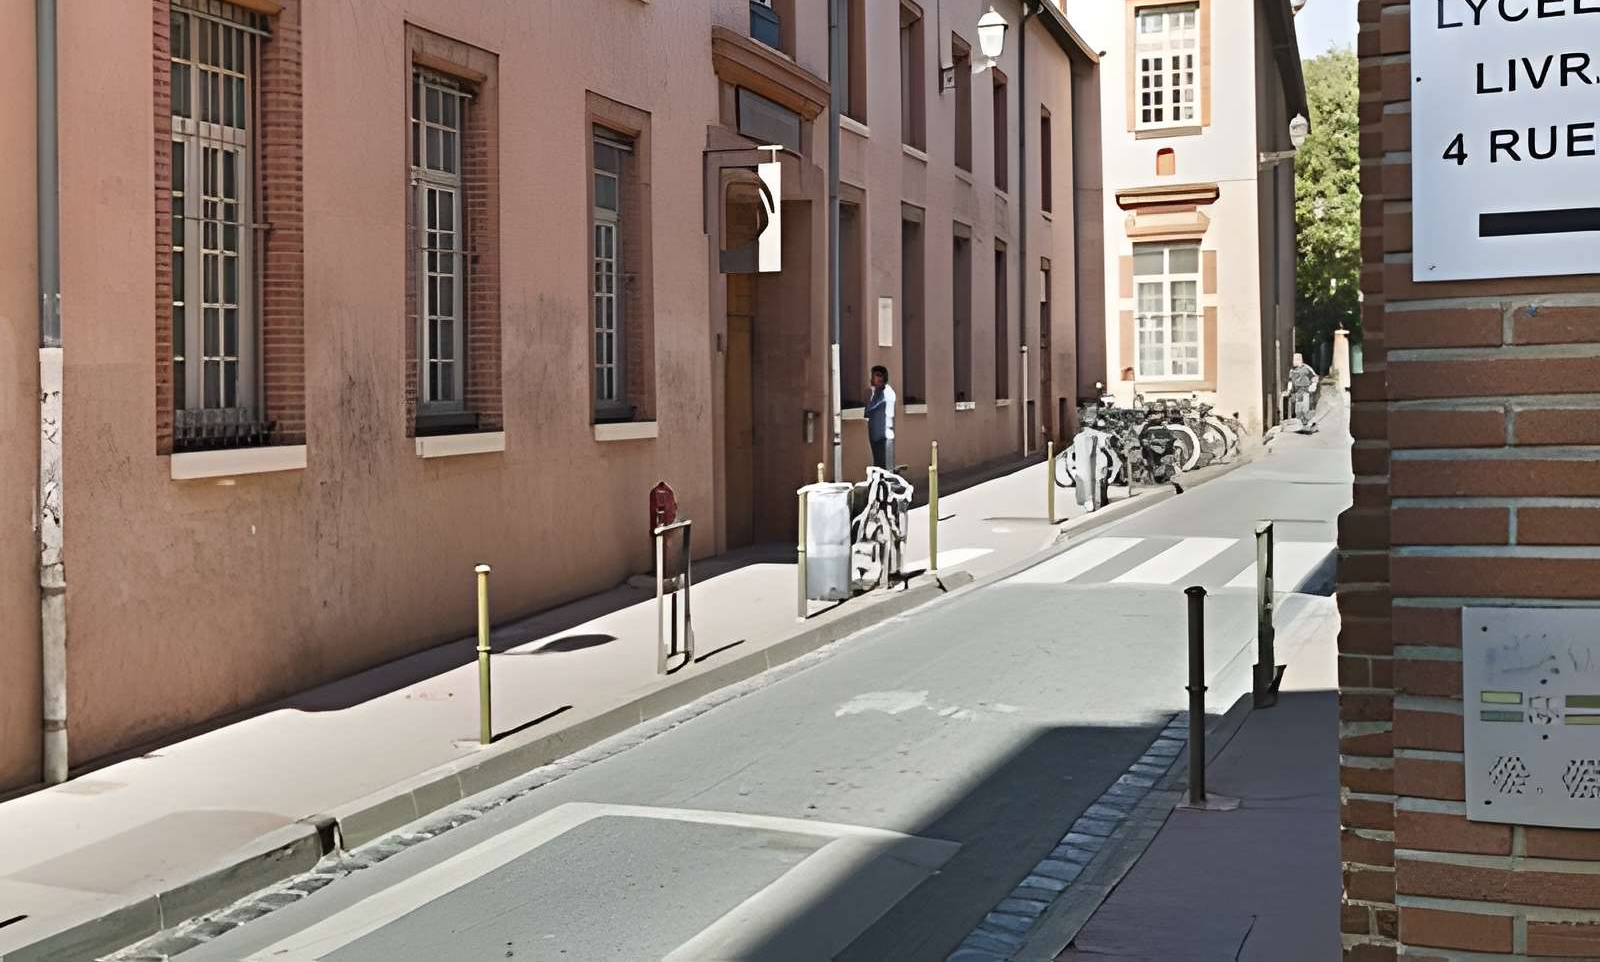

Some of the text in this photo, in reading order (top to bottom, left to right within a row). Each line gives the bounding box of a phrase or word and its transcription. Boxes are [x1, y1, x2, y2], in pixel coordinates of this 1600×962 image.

[1476, 52, 1600, 95] LIVR
[1442, 122, 1595, 166] 4 RUE
